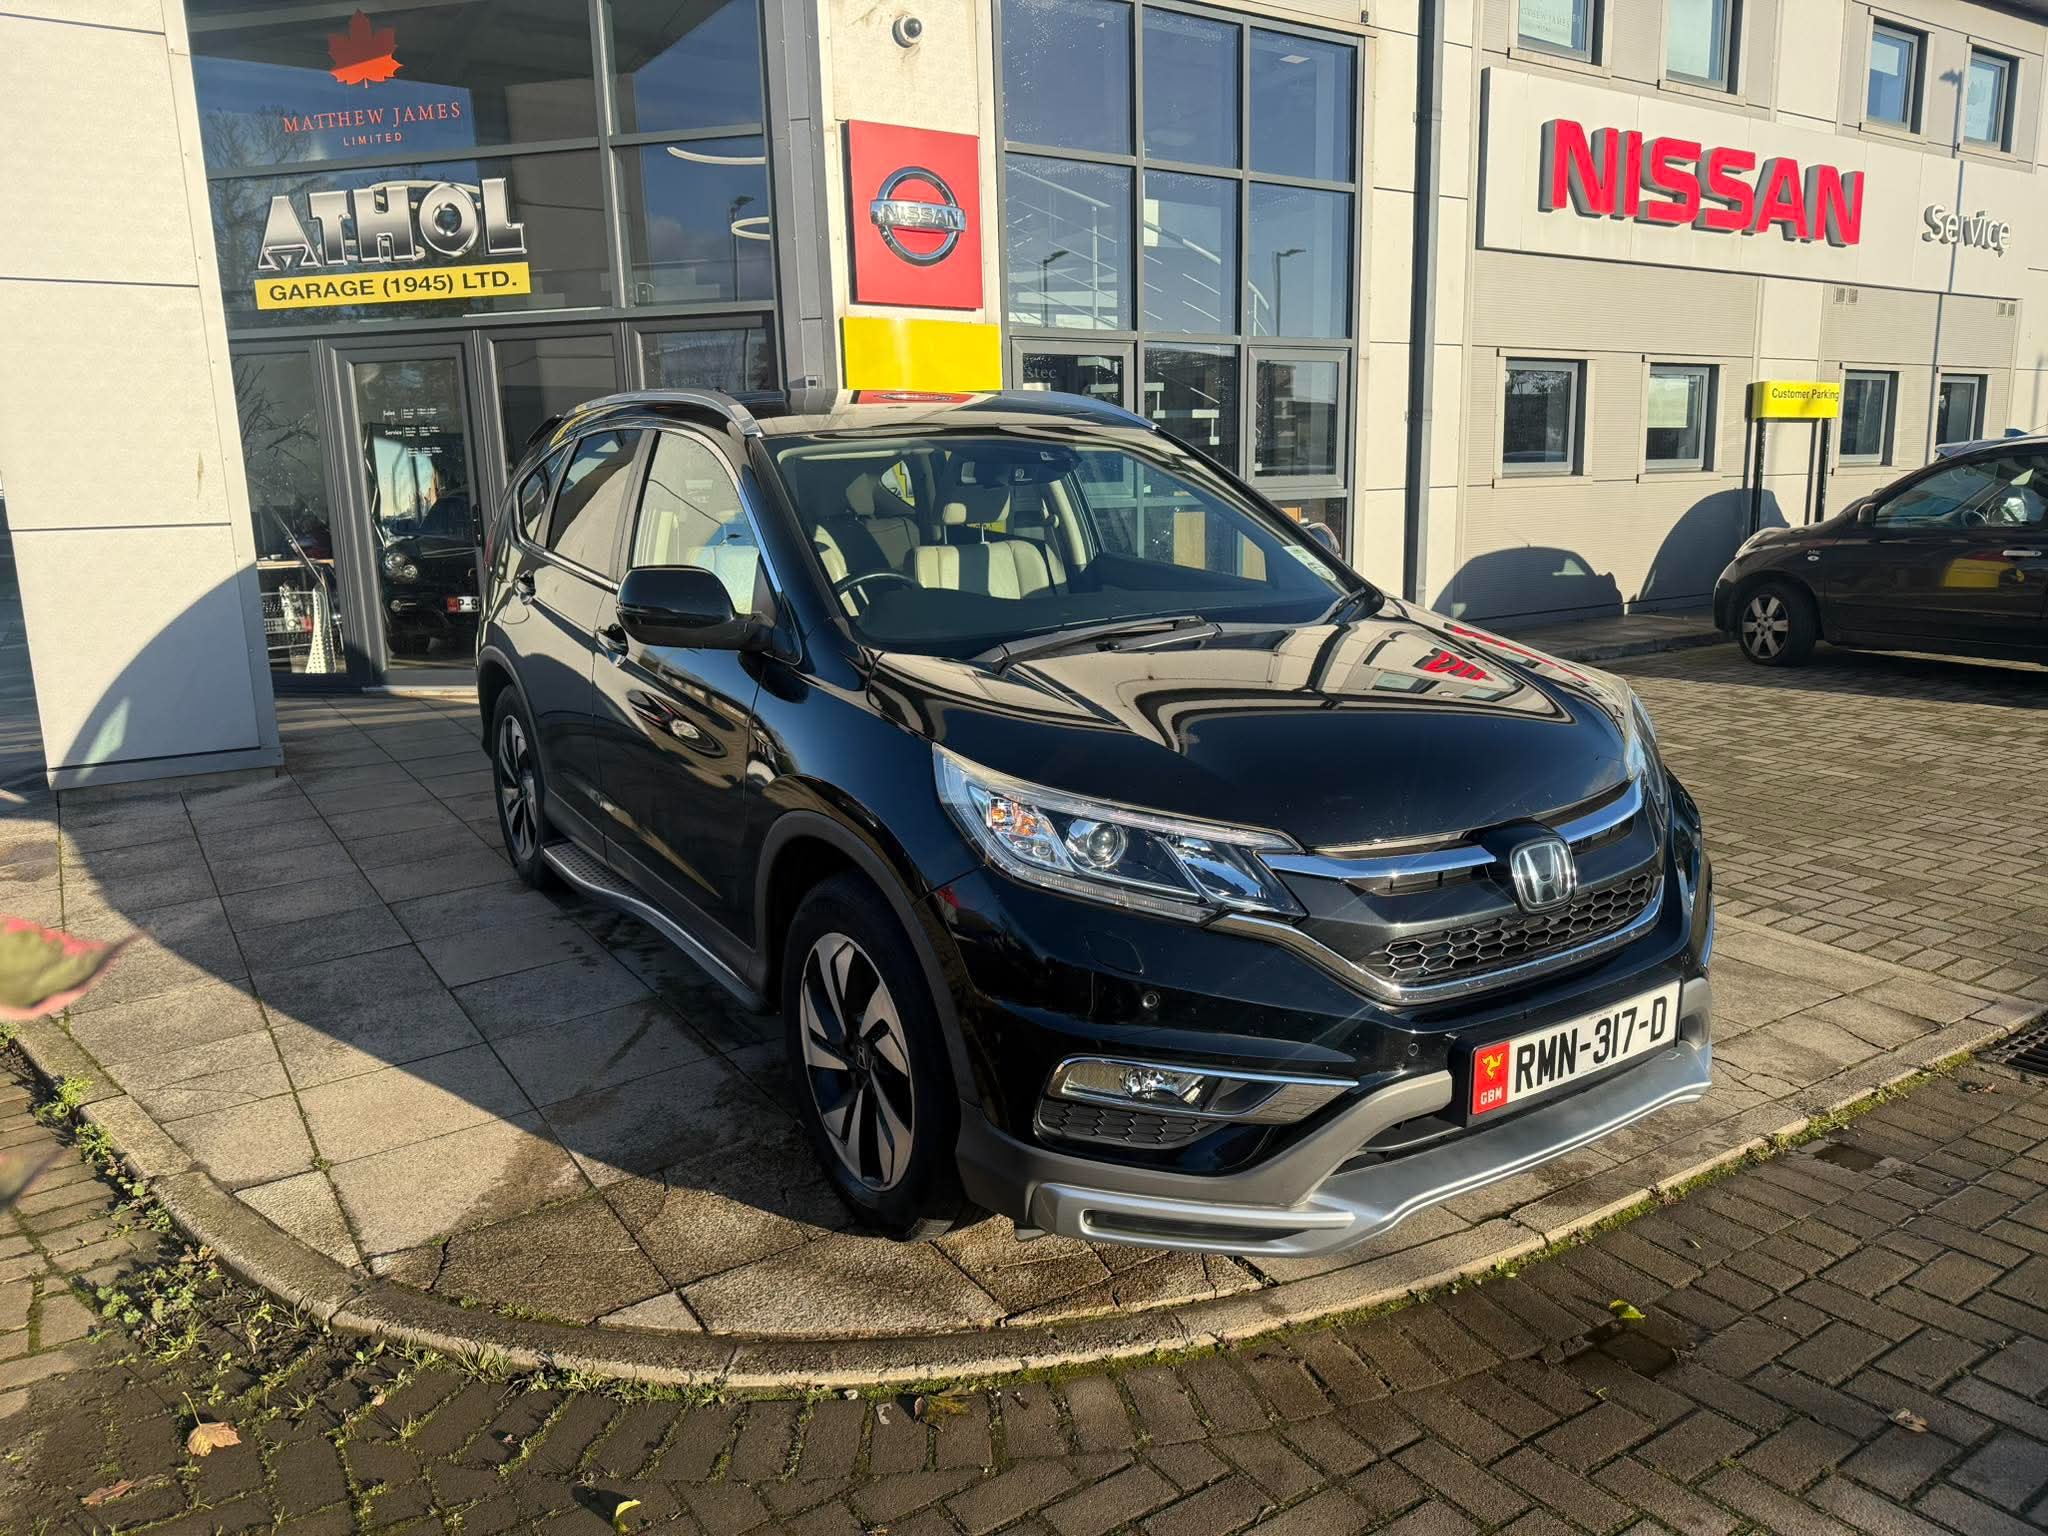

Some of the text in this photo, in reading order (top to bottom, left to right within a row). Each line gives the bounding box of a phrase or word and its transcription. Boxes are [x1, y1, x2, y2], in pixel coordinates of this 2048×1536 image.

[283, 102, 461, 133] MATTHEW JAMES
[343, 132, 403, 146] LIMITED
[1538, 119, 1864, 247] NISSAN
[257, 177, 527, 271] ATHOL
[882, 204, 959, 228] NISSAN
[1922, 204, 2011, 249] Service
[270, 271, 517, 301] GARAGE (1945) LTD.
[1771, 388, 1840, 402] Customer Parking
[1514, 995, 1667, 1094] RMN-317-D
[1480, 1087, 1503, 1105] GBM
